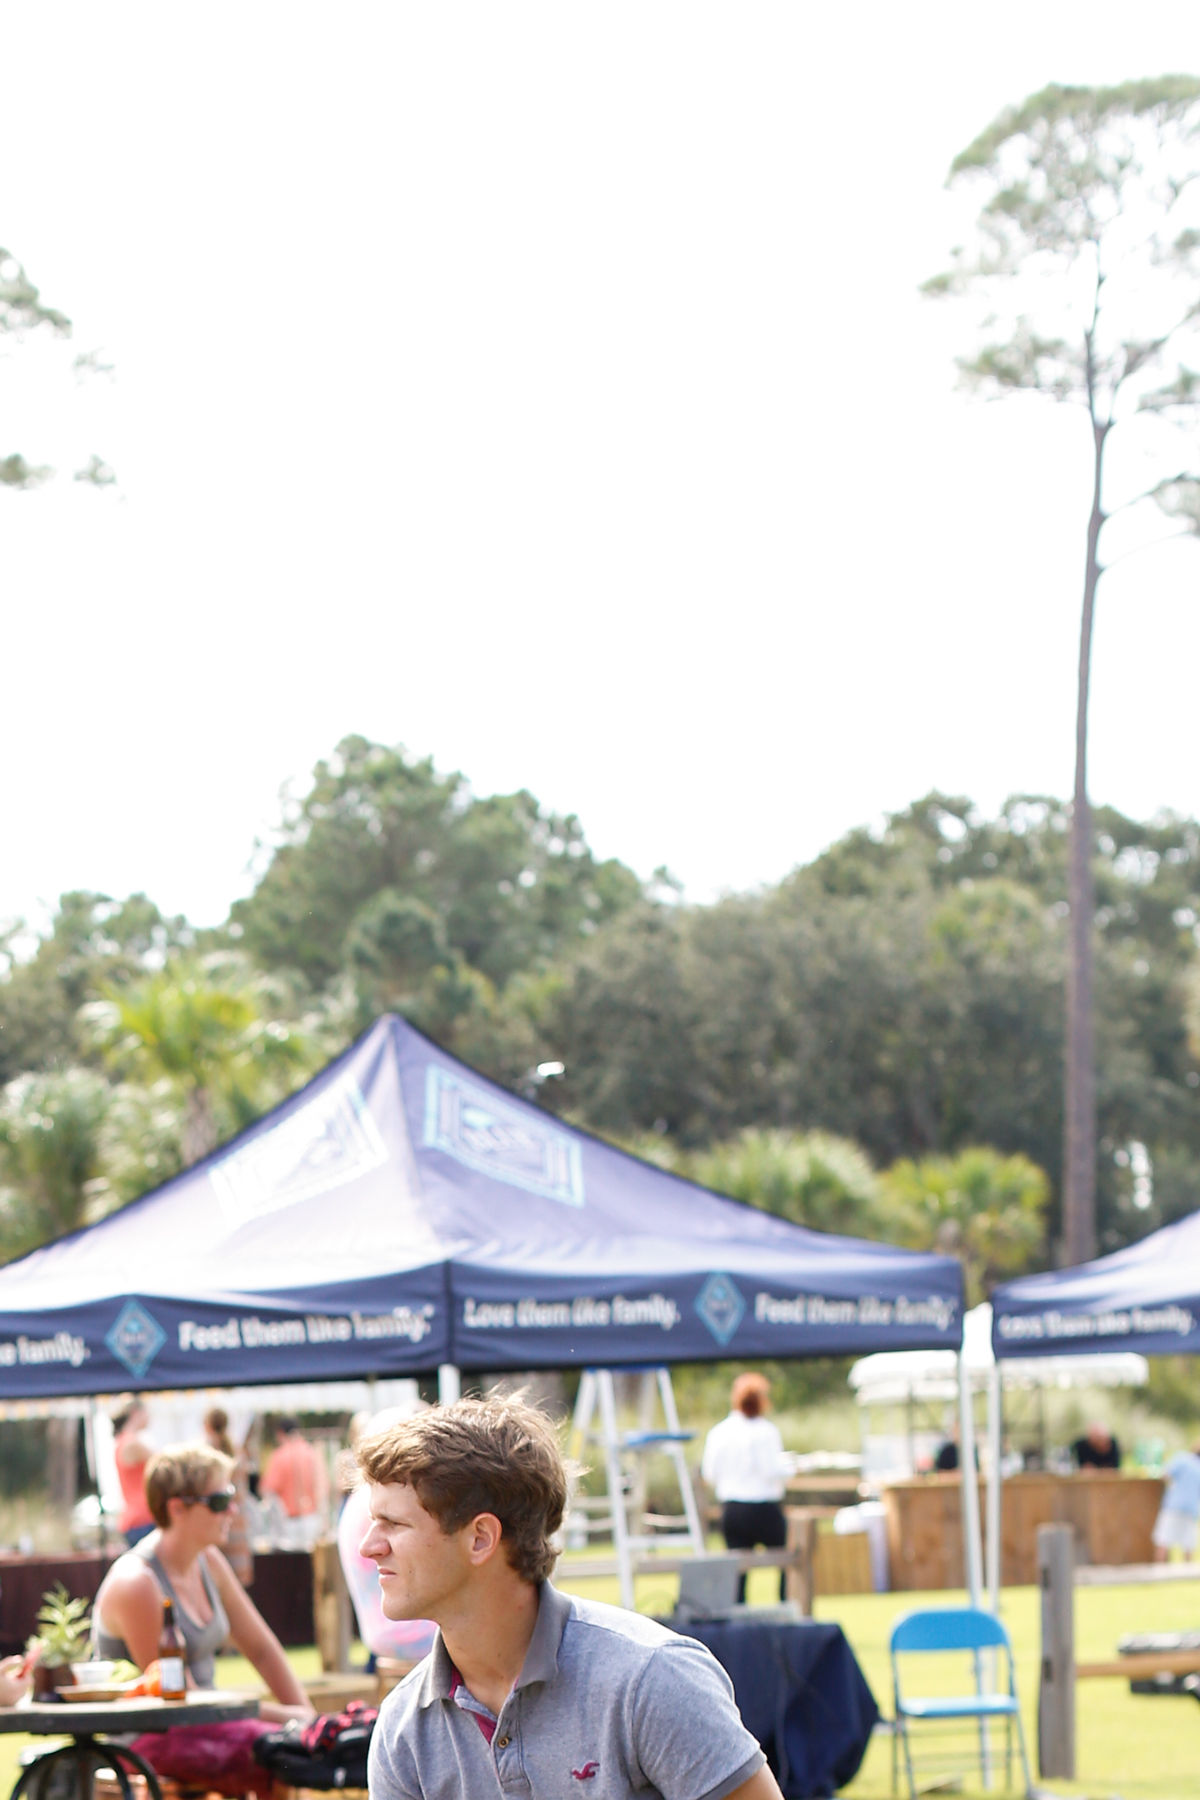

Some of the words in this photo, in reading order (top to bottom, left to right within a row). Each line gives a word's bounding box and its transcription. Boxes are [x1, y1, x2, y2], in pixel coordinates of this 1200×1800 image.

[464, 1297, 515, 1328] Love
[516, 1296, 571, 1327] them
[571, 1296, 611, 1326] like
[755, 1293, 804, 1324] Feed
[178, 1317, 241, 1350] Feed
[241, 1316, 306, 1348] them
[306, 1314, 351, 1343] like
